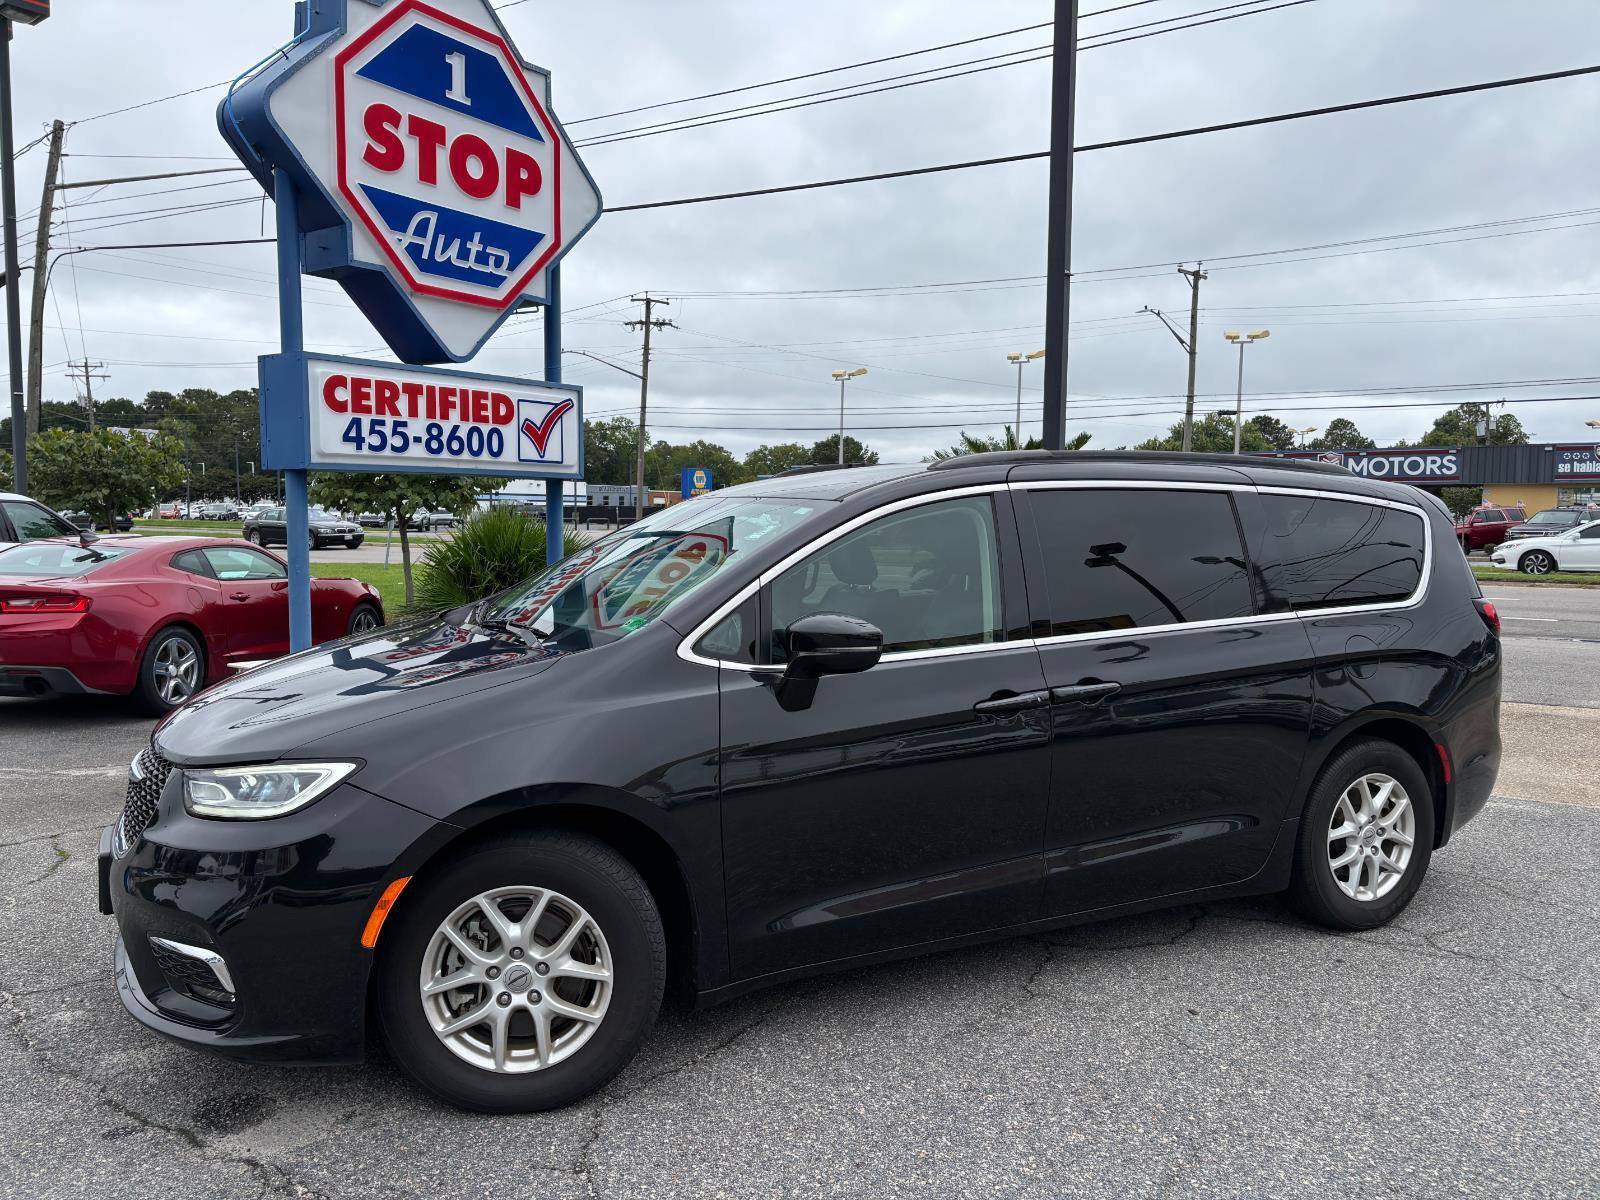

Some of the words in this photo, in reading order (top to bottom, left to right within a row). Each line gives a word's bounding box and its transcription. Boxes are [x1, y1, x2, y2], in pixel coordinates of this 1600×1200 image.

[445, 51, 472, 106] 1
[362, 103, 542, 209] STOP
[394, 210, 512, 277] Auto
[322, 374, 515, 426] CERTIFIED
[342, 417, 504, 458] 455-8600
[1347, 456, 1457, 476] MOTORS
[1558, 463, 1571, 473] se
